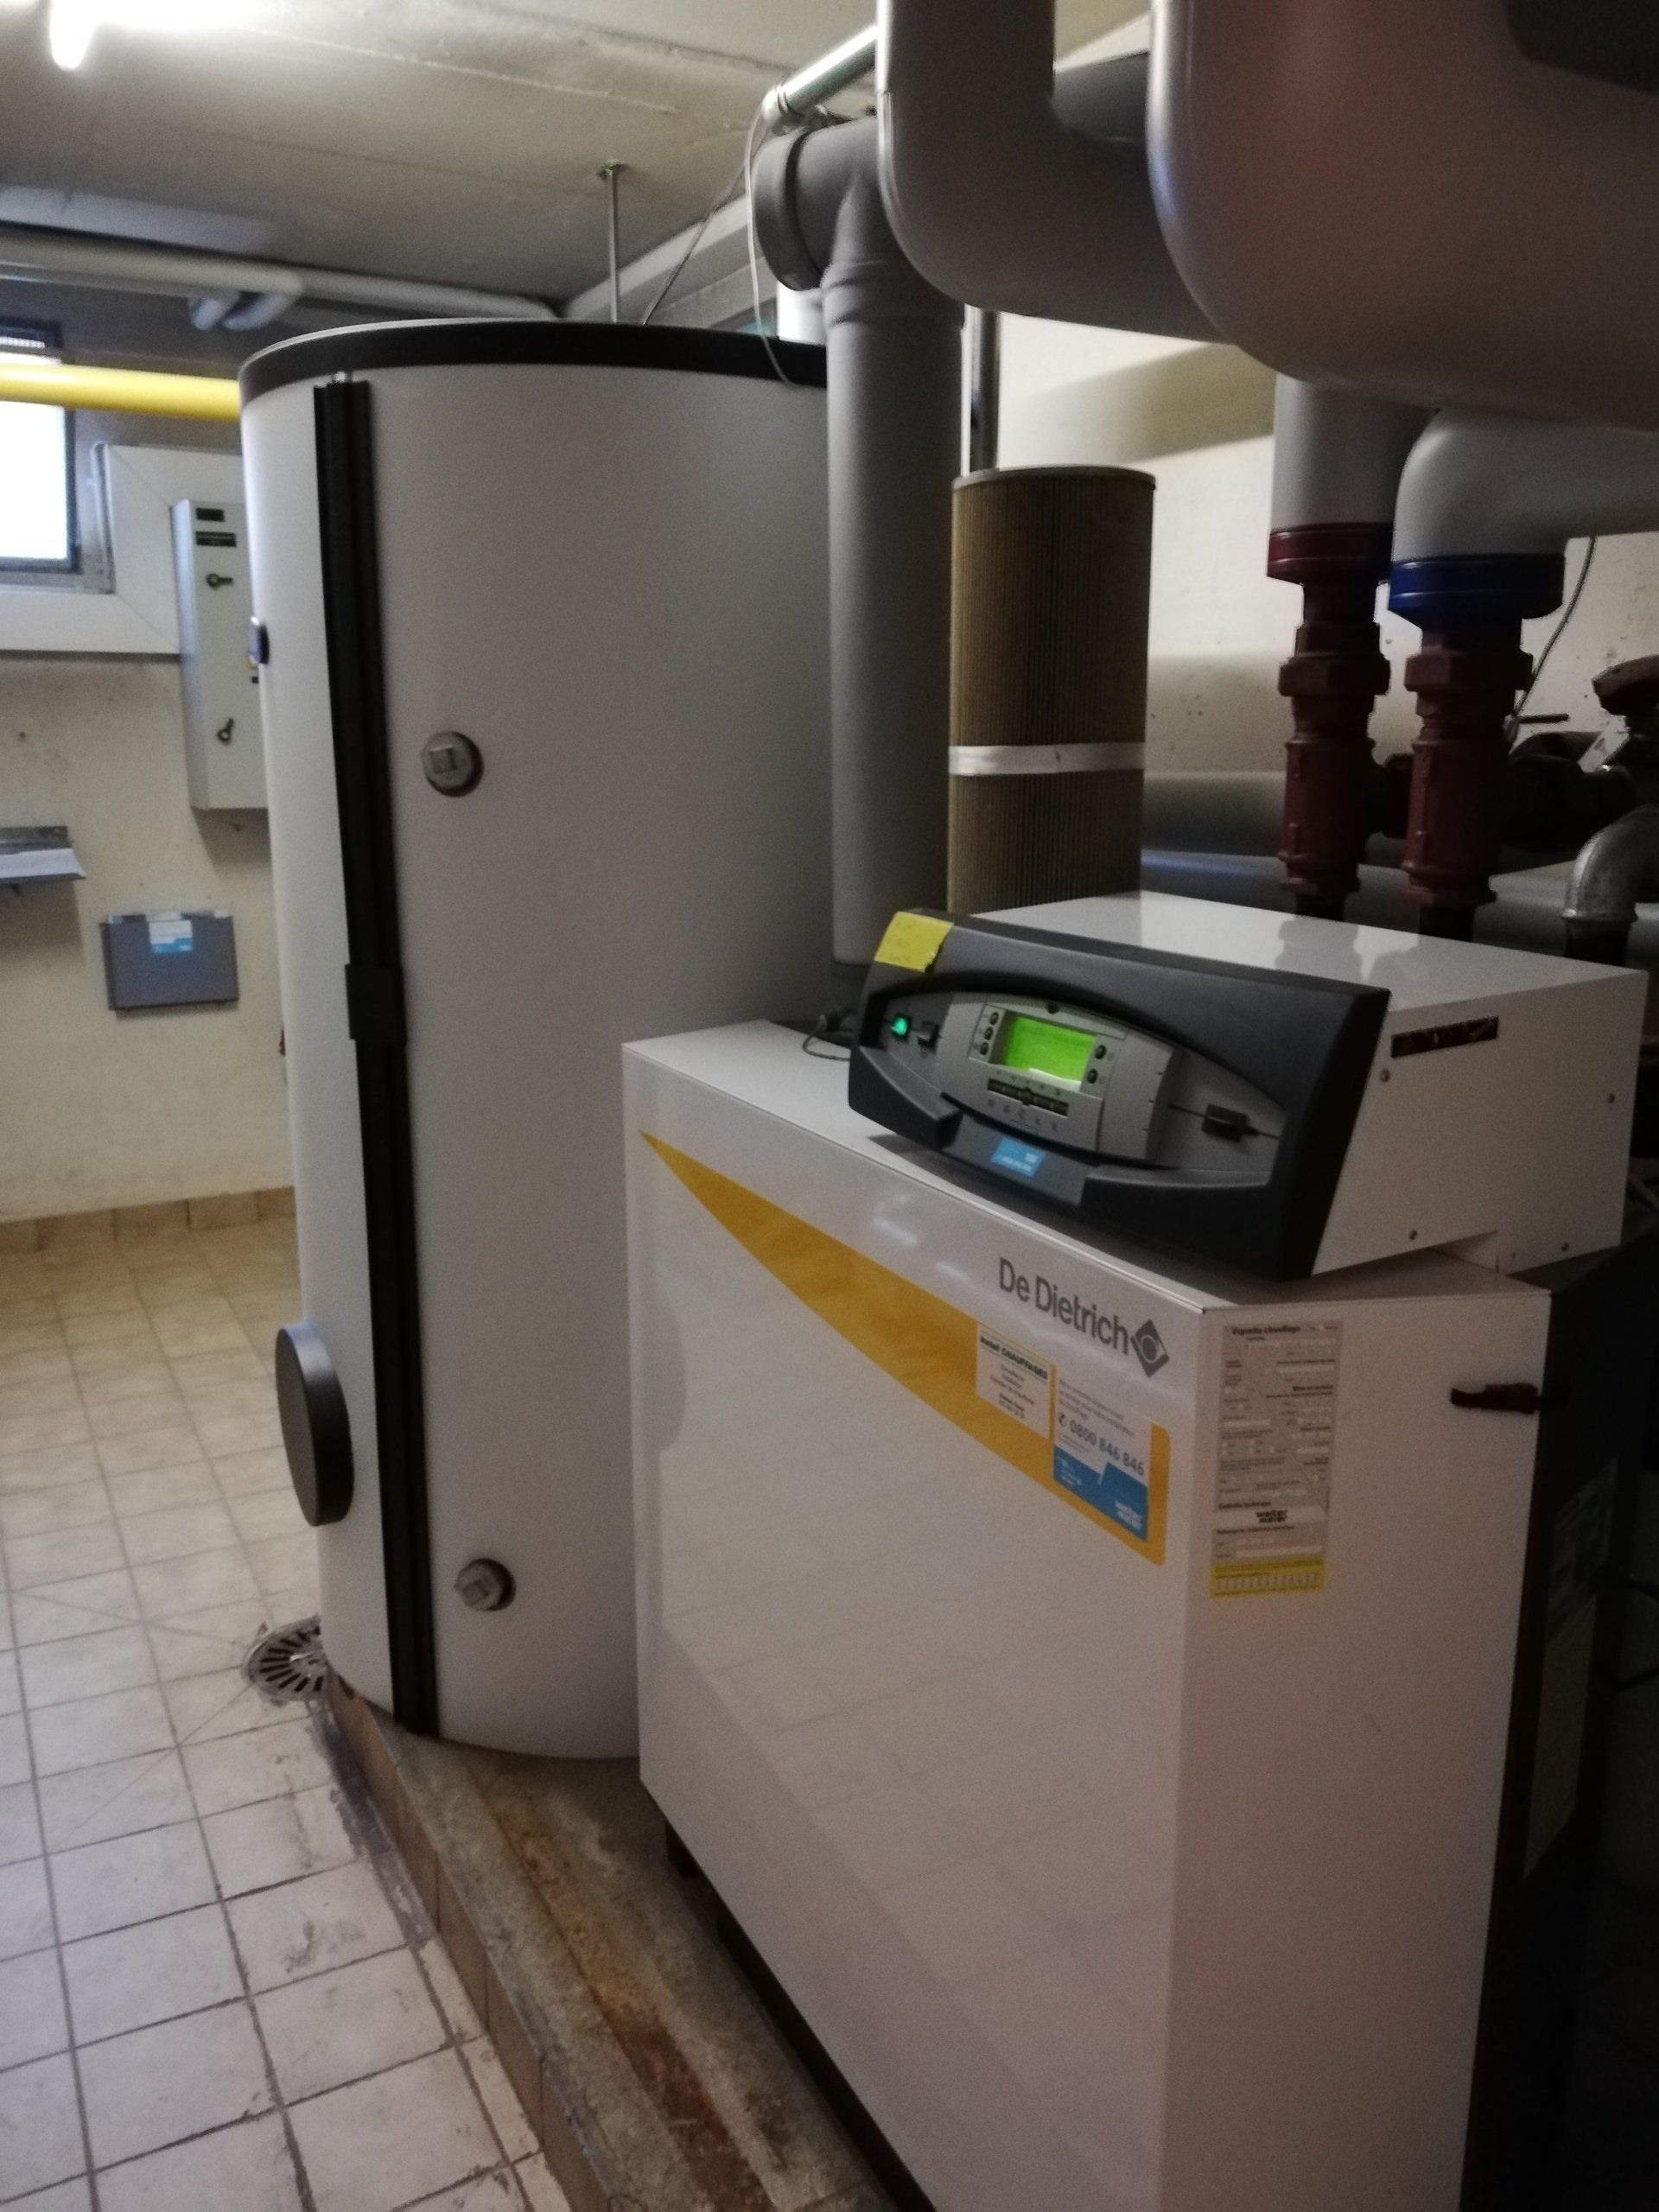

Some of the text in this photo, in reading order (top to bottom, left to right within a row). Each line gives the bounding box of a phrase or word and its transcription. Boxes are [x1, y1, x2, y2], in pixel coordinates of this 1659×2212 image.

[1000, 1257, 1129, 1355] De Dietrich
[1070, 1419, 1097, 1446] 0800
[1099, 1437, 1120, 1460] 846
[1122, 1452, 1145, 1476] 846
